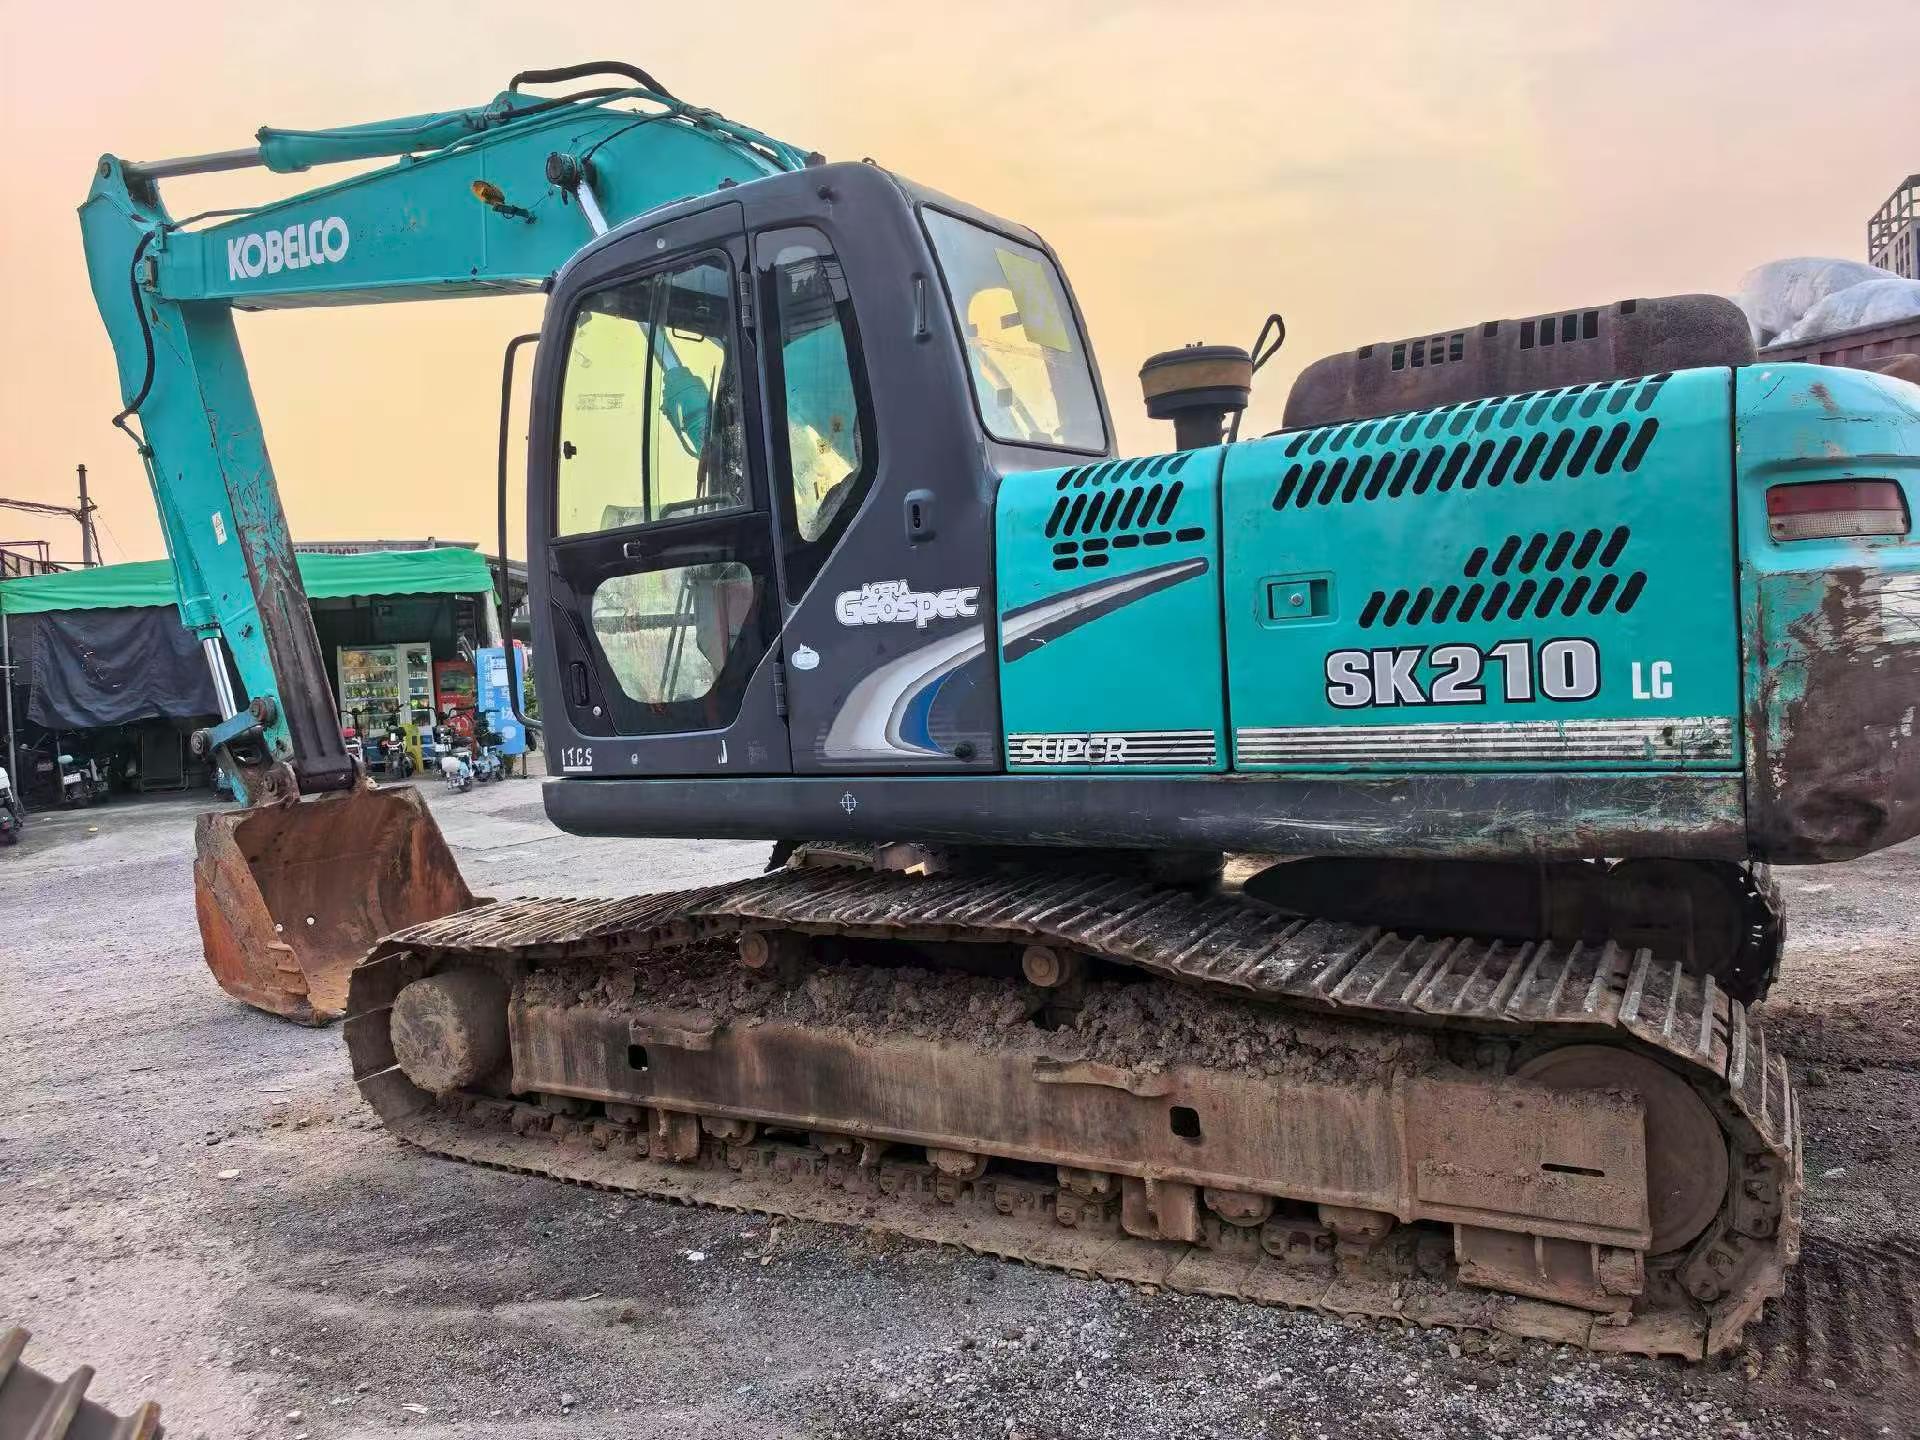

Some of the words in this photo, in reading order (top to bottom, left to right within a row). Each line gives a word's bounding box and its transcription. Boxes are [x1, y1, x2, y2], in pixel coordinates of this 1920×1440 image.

[227, 216, 350, 281] KOBELCO
[1326, 637, 1600, 708] SK210
[1631, 660, 1673, 700] LC
[1020, 737, 1128, 763] SUPER
